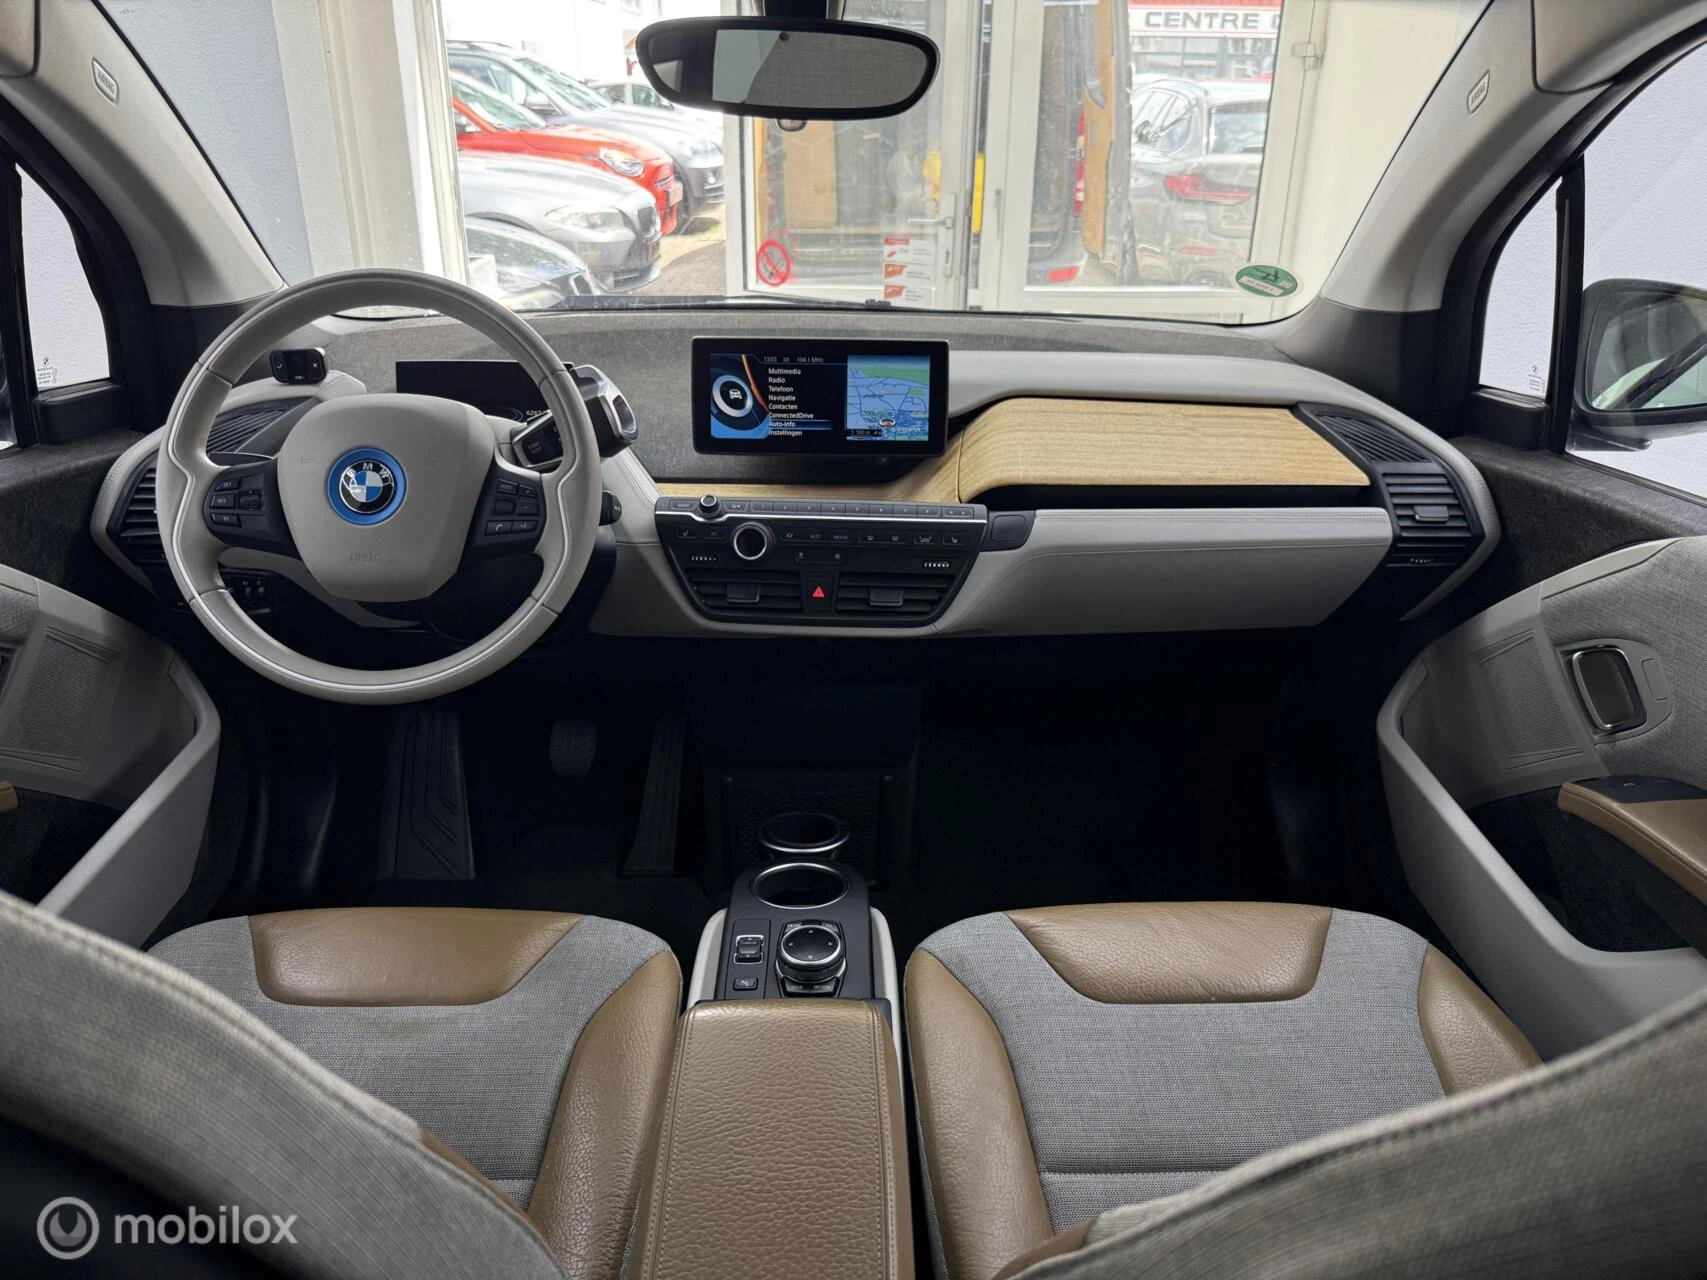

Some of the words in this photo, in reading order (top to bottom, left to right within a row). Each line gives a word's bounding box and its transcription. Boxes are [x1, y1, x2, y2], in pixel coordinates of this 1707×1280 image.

[1144, 11, 1261, 30] CENTRE
[768, 367, 802, 375] Multimedia
[768, 376, 786, 384] Radio
[768, 385, 794, 393] Telefoon
[768, 394, 796, 402] Navigatie
[345, 462, 390, 480] BMW
